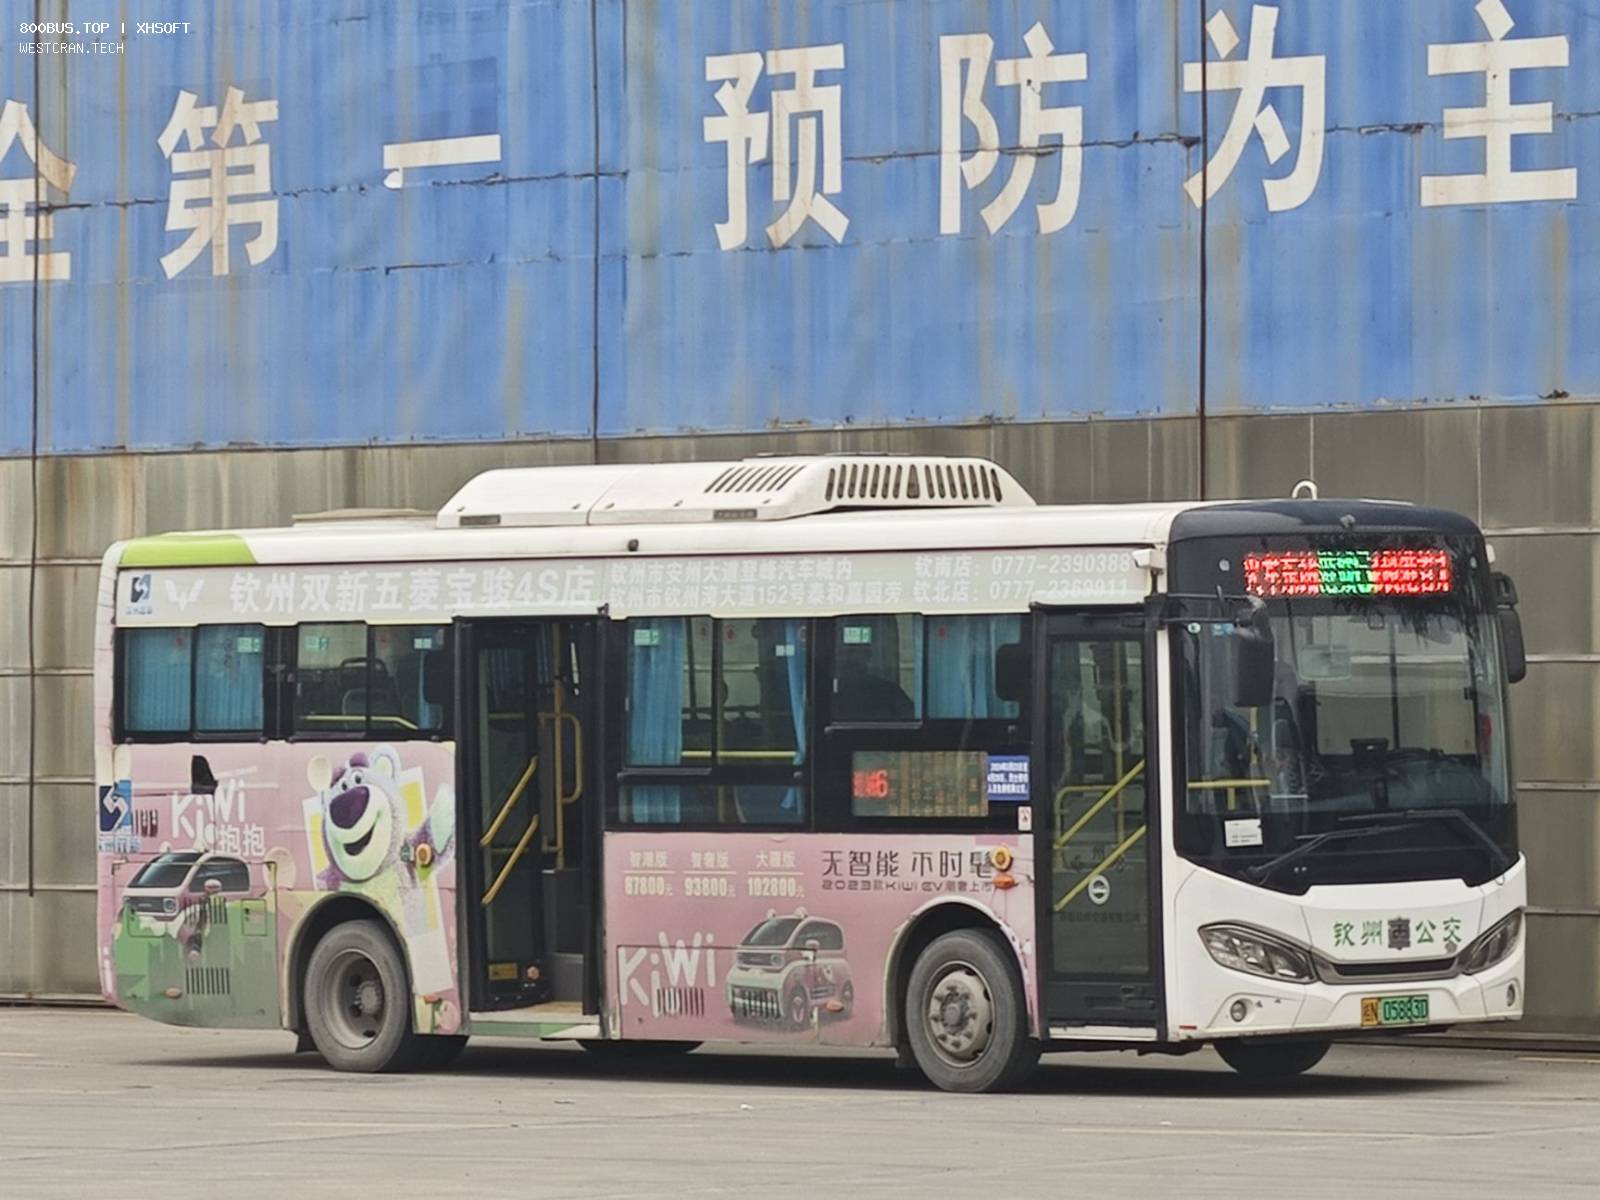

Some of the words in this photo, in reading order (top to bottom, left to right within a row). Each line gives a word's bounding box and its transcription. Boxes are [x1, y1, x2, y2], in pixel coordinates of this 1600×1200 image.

[703, 0, 1578, 250] 预防为主
[230, 564, 597, 614] 钦州双新五菱宝骏4S店
[217, 823, 265, 857] 抱抱
[821, 850, 900, 878] 无智能
[1332, 921, 1383, 947] 钦州
[1415, 917, 1462, 944] 公交
[619, 930, 717, 1020] KiWi
